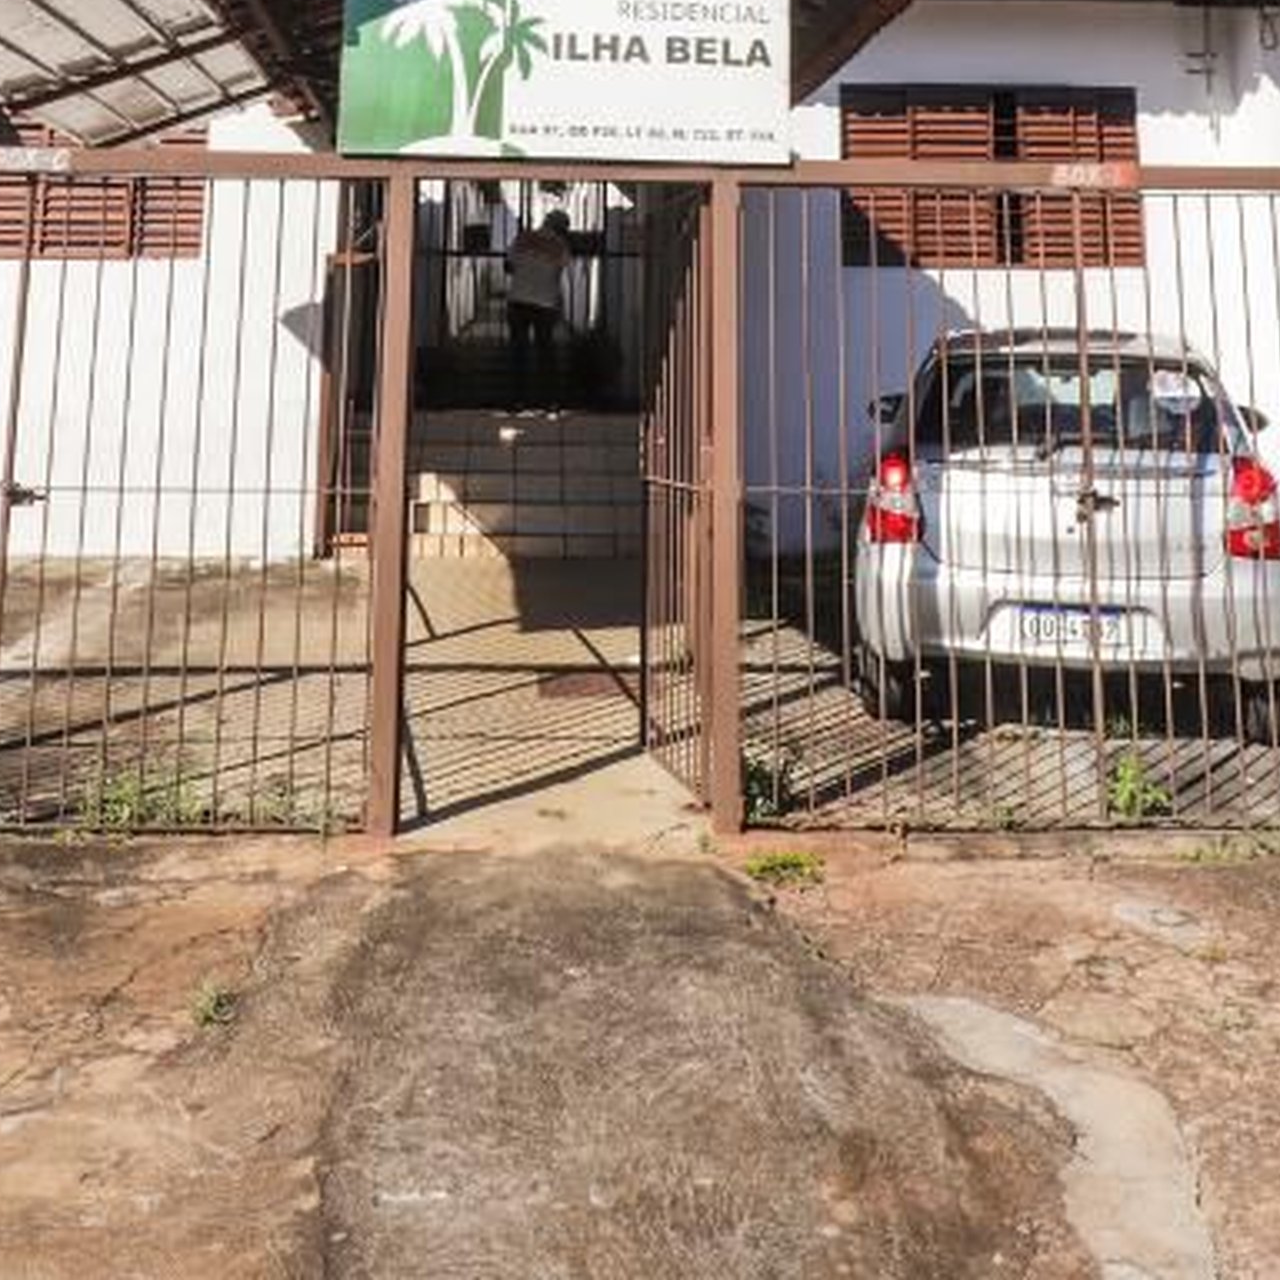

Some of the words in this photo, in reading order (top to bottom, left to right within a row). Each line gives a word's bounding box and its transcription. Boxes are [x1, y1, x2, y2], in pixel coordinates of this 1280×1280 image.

[618, 0, 772, 24] RESIDENCIAL
[552, 33, 651, 63] ILHA
[665, 37, 773, 68] BELA
